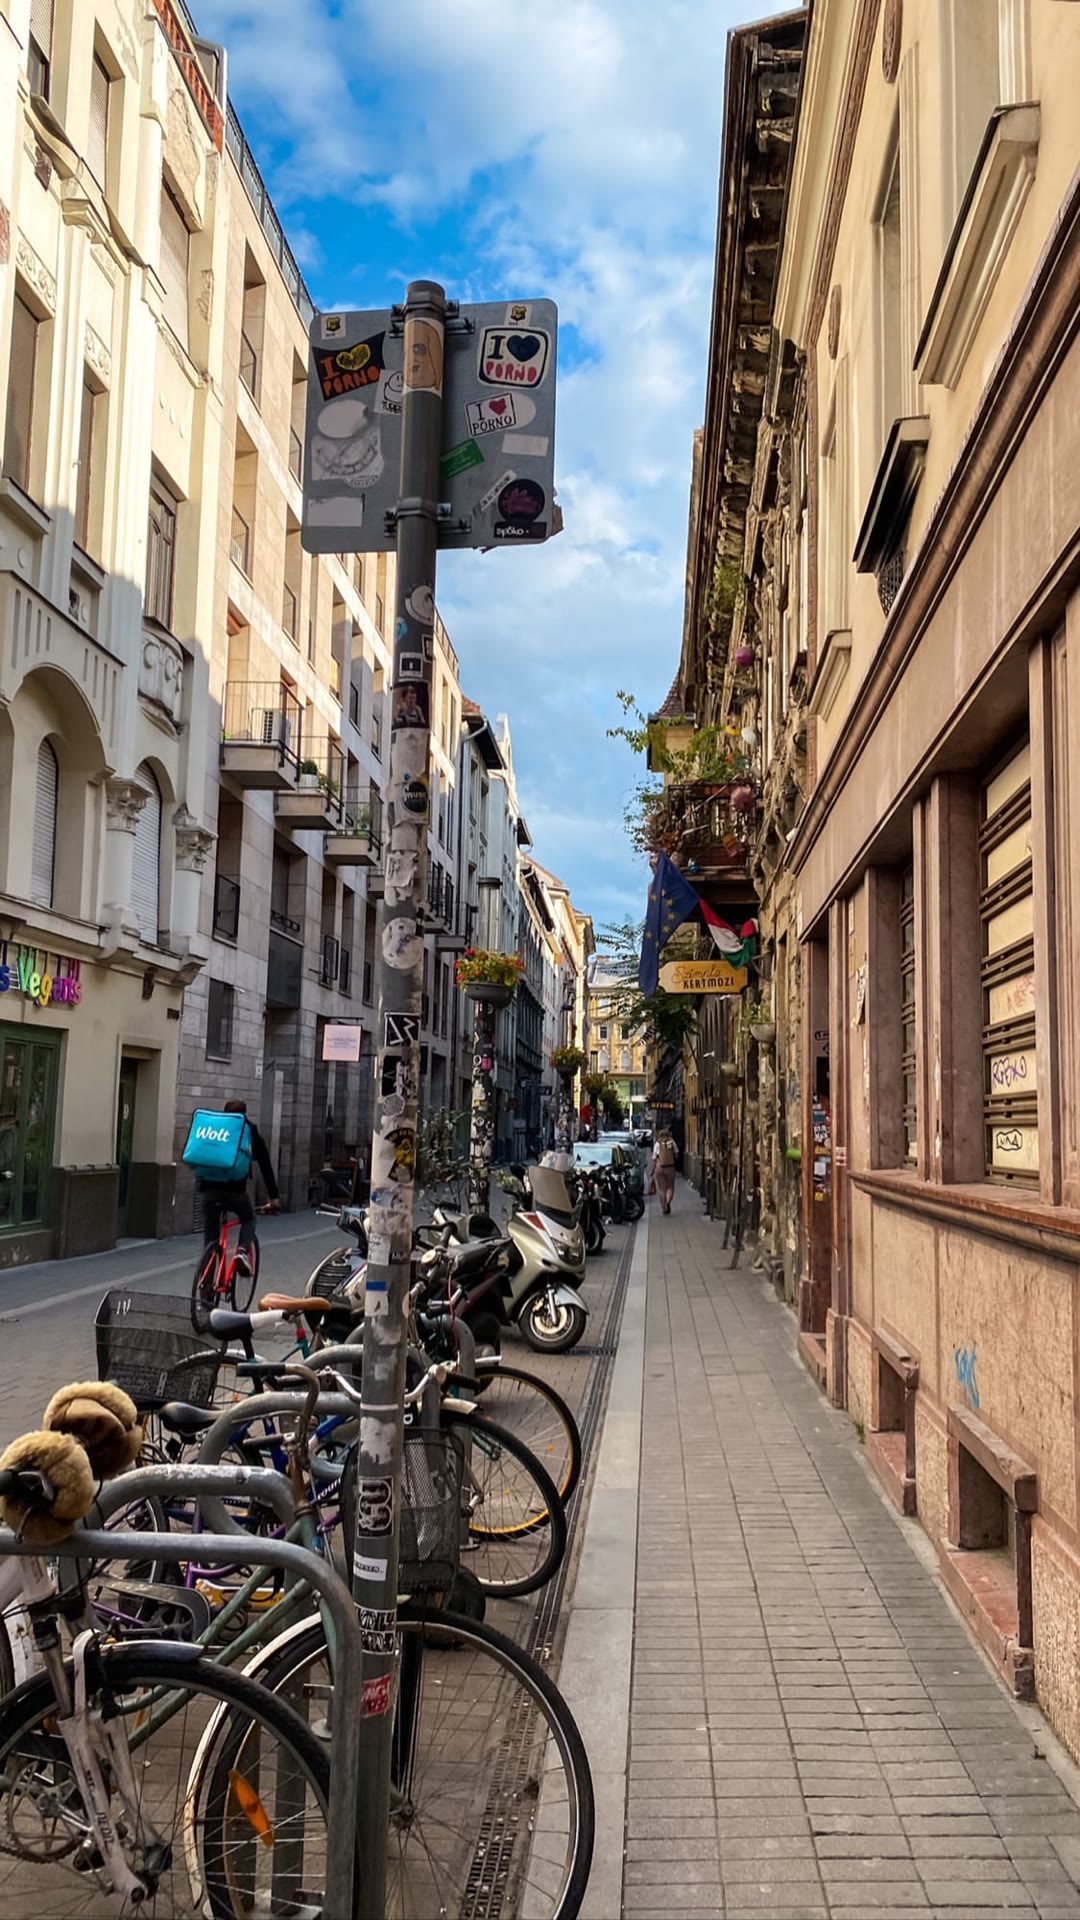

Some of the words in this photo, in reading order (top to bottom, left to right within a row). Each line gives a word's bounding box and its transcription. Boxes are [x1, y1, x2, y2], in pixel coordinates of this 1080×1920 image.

[323, 365, 380, 396] PORNO
[485, 361, 537, 383] PORNO
[472, 415, 512, 434] PORNO
[18, 953, 82, 1006] Vegans
[683, 976, 734, 989] KERTMOZI
[196, 1125, 230, 1143] Wolt
